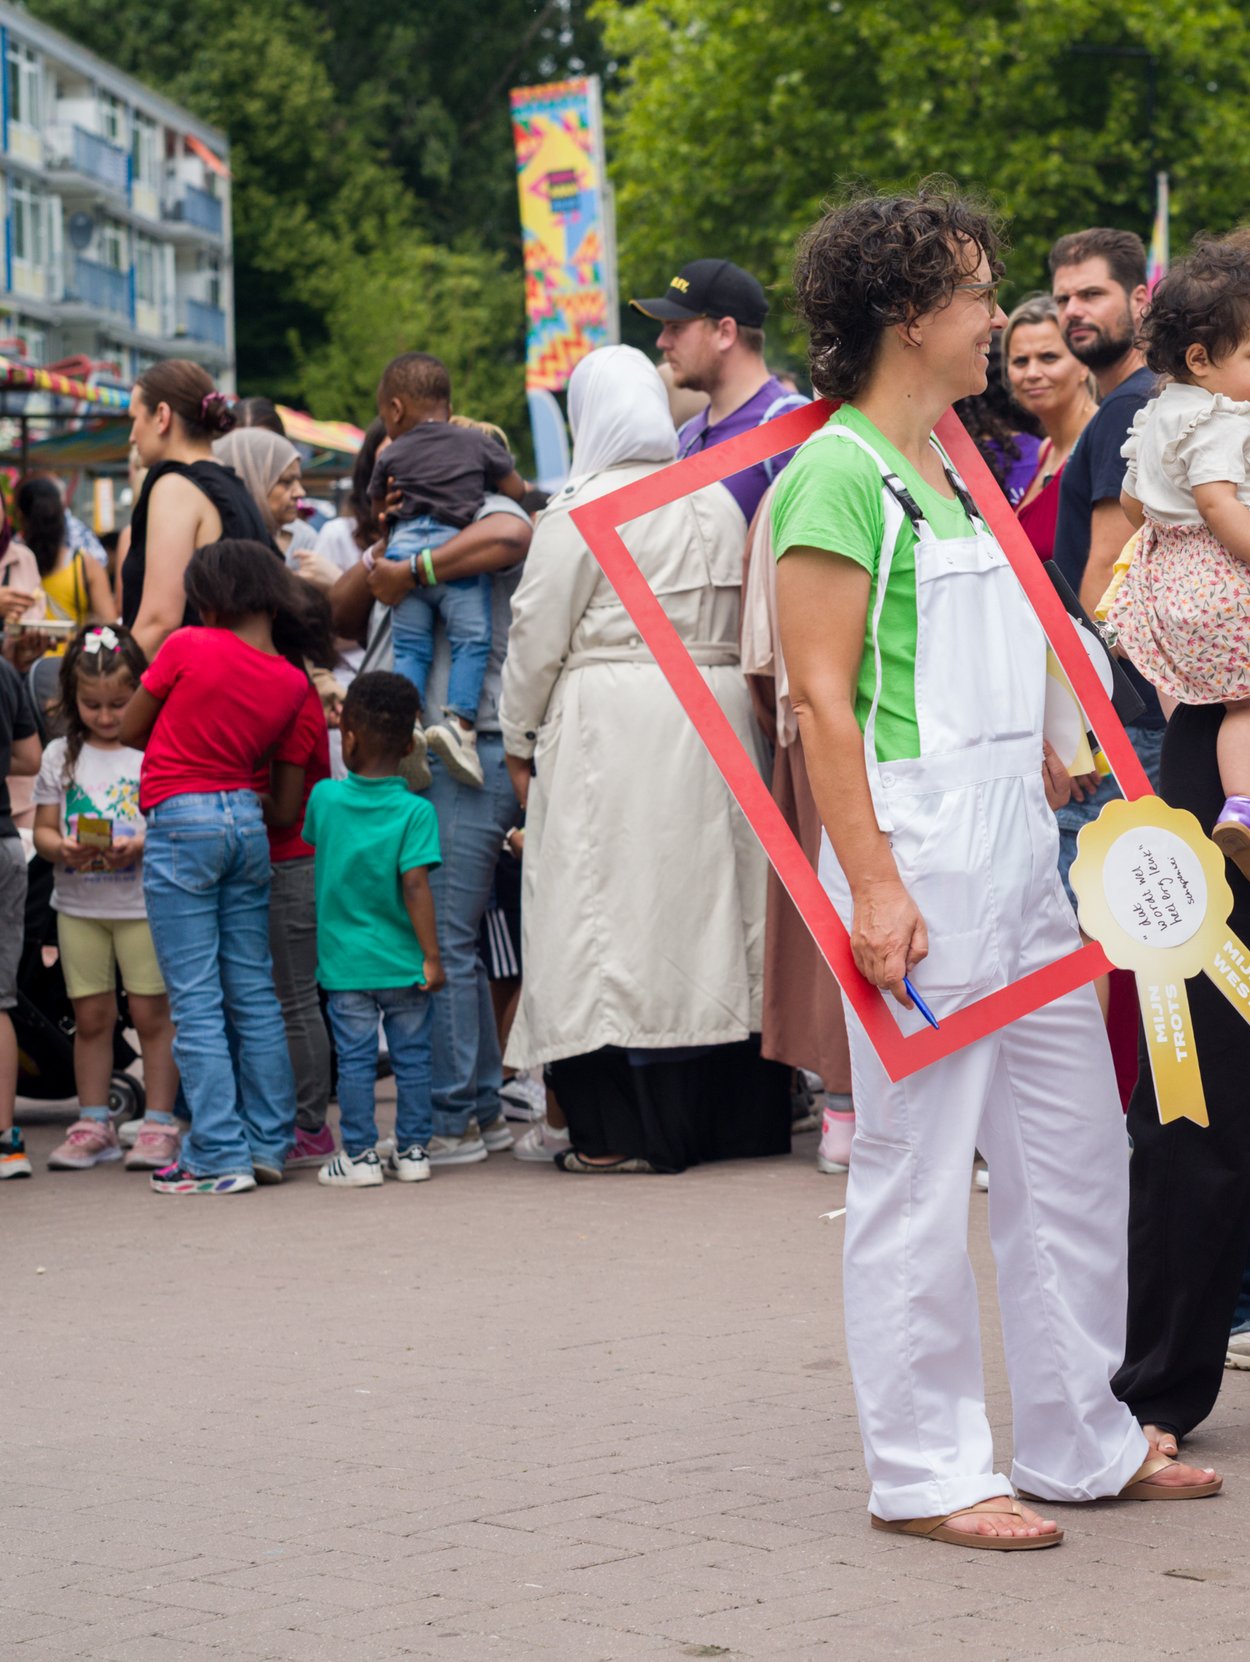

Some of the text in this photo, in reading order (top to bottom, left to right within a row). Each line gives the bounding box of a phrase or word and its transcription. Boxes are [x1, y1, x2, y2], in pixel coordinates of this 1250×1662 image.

[1158, 877, 1174, 900] erg
[1165, 903, 1183, 926] heel
[1148, 985, 1168, 1043] MIJN
[1165, 983, 1188, 1063] TROTS
